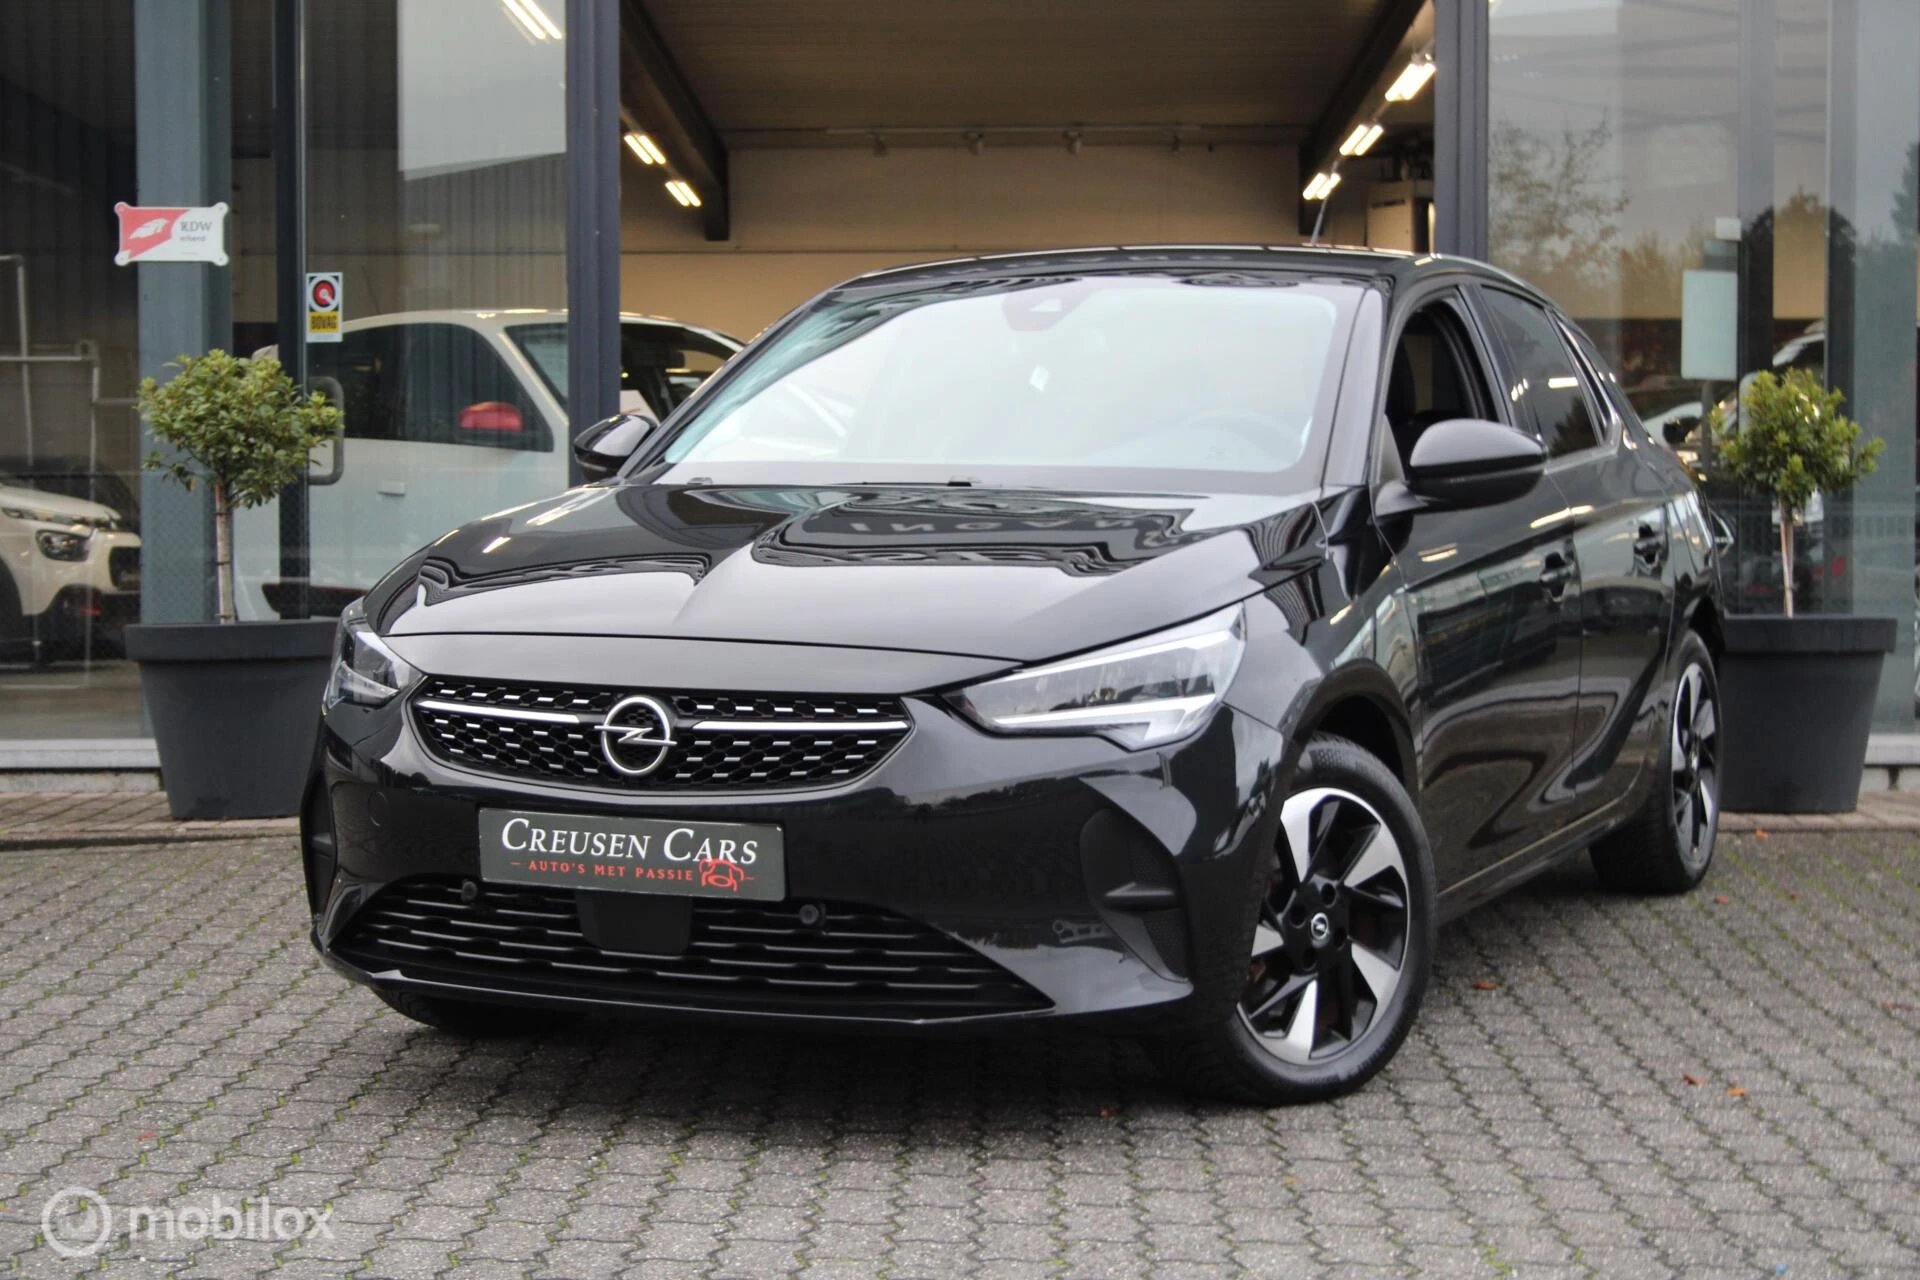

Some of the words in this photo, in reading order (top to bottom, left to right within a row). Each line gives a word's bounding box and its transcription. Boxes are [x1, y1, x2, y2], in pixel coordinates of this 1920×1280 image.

[180, 220, 213, 232] RDW
[528, 860, 586, 875] AUTO'S
[594, 865, 626, 877] MET
[636, 868, 693, 881] PASSIE
